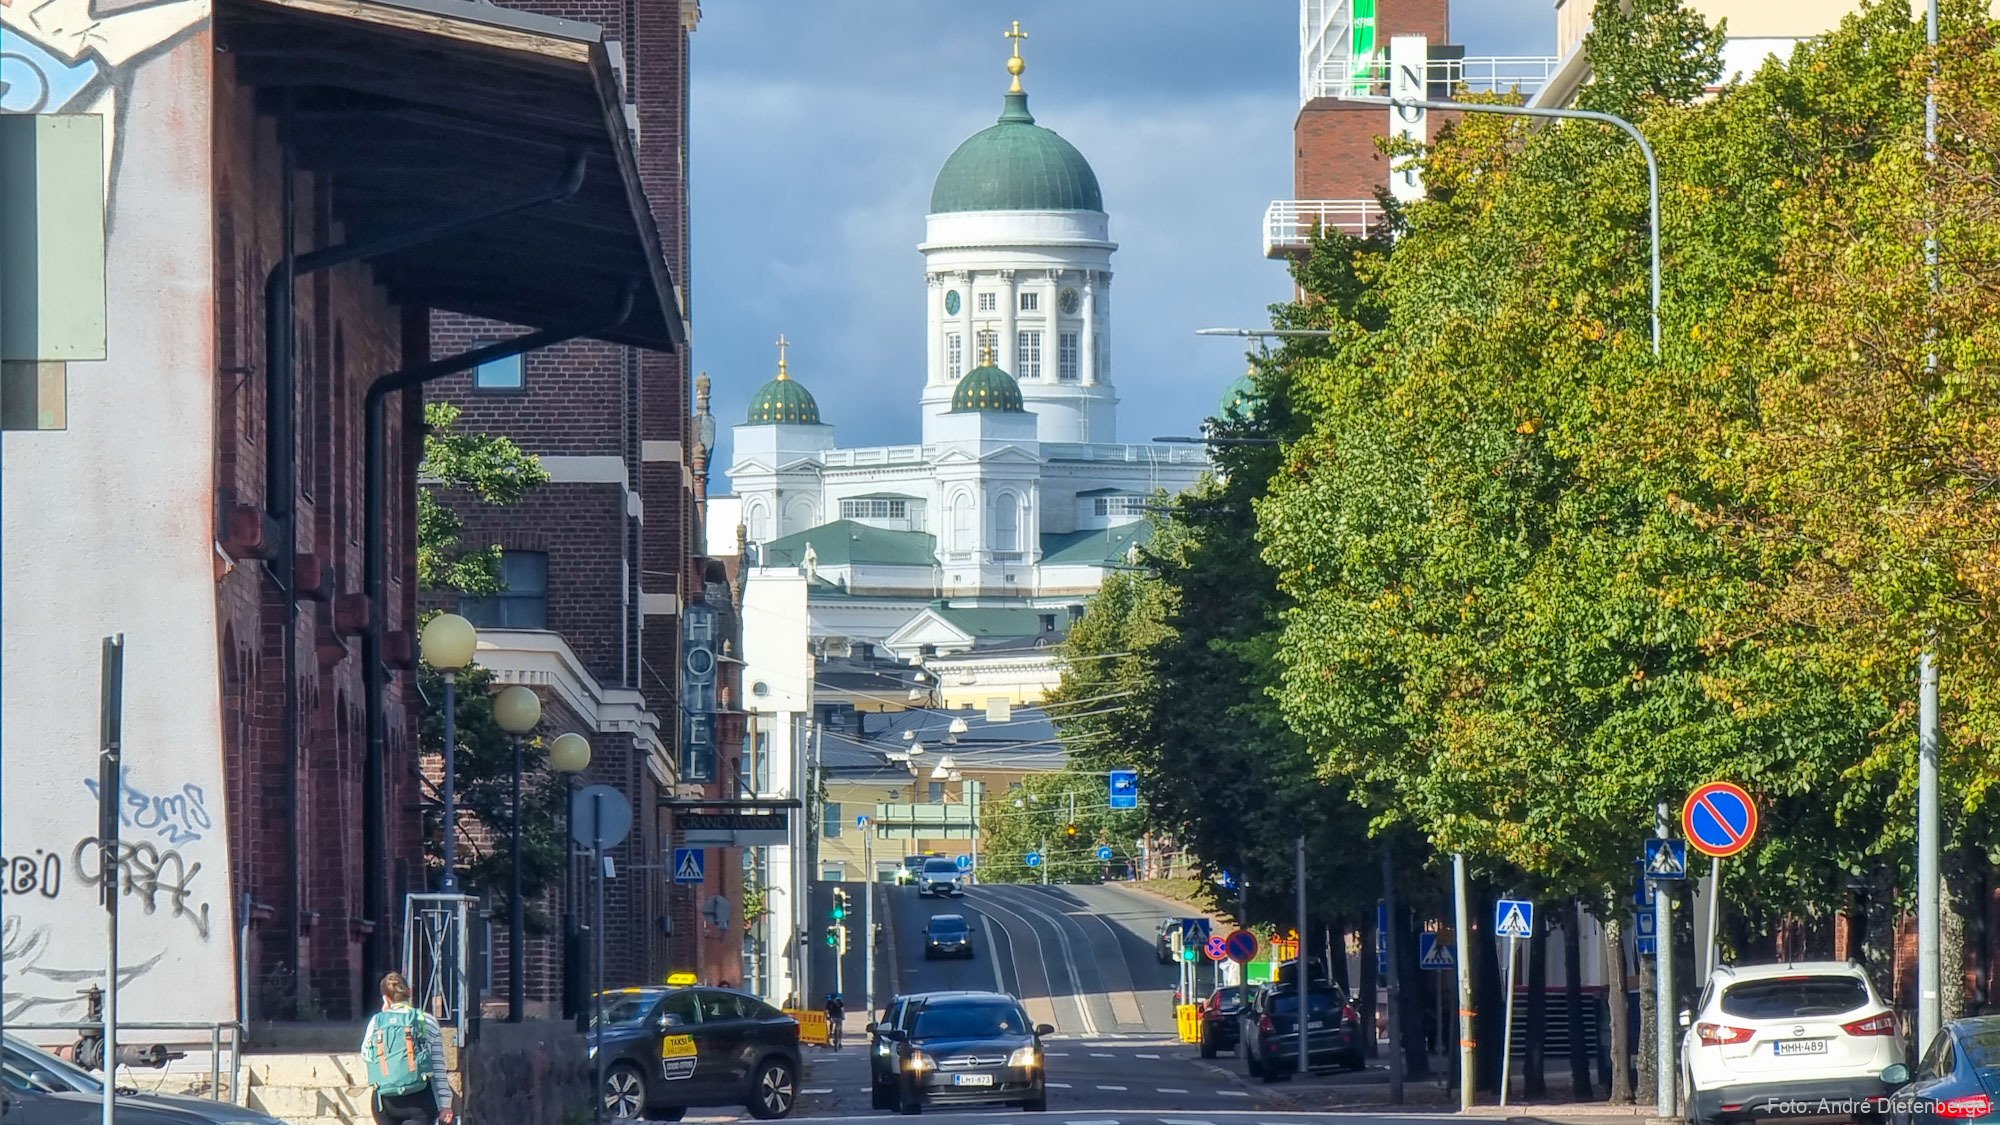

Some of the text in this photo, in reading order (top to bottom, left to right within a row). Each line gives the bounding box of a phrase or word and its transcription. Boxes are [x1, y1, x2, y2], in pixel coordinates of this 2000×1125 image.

[687, 613, 714, 780] HOTEL
[680, 816, 783, 829] GRAND MARINA
[670, 1037, 689, 1046] TAKSI
[1780, 1041, 1824, 1054] MMH-489
